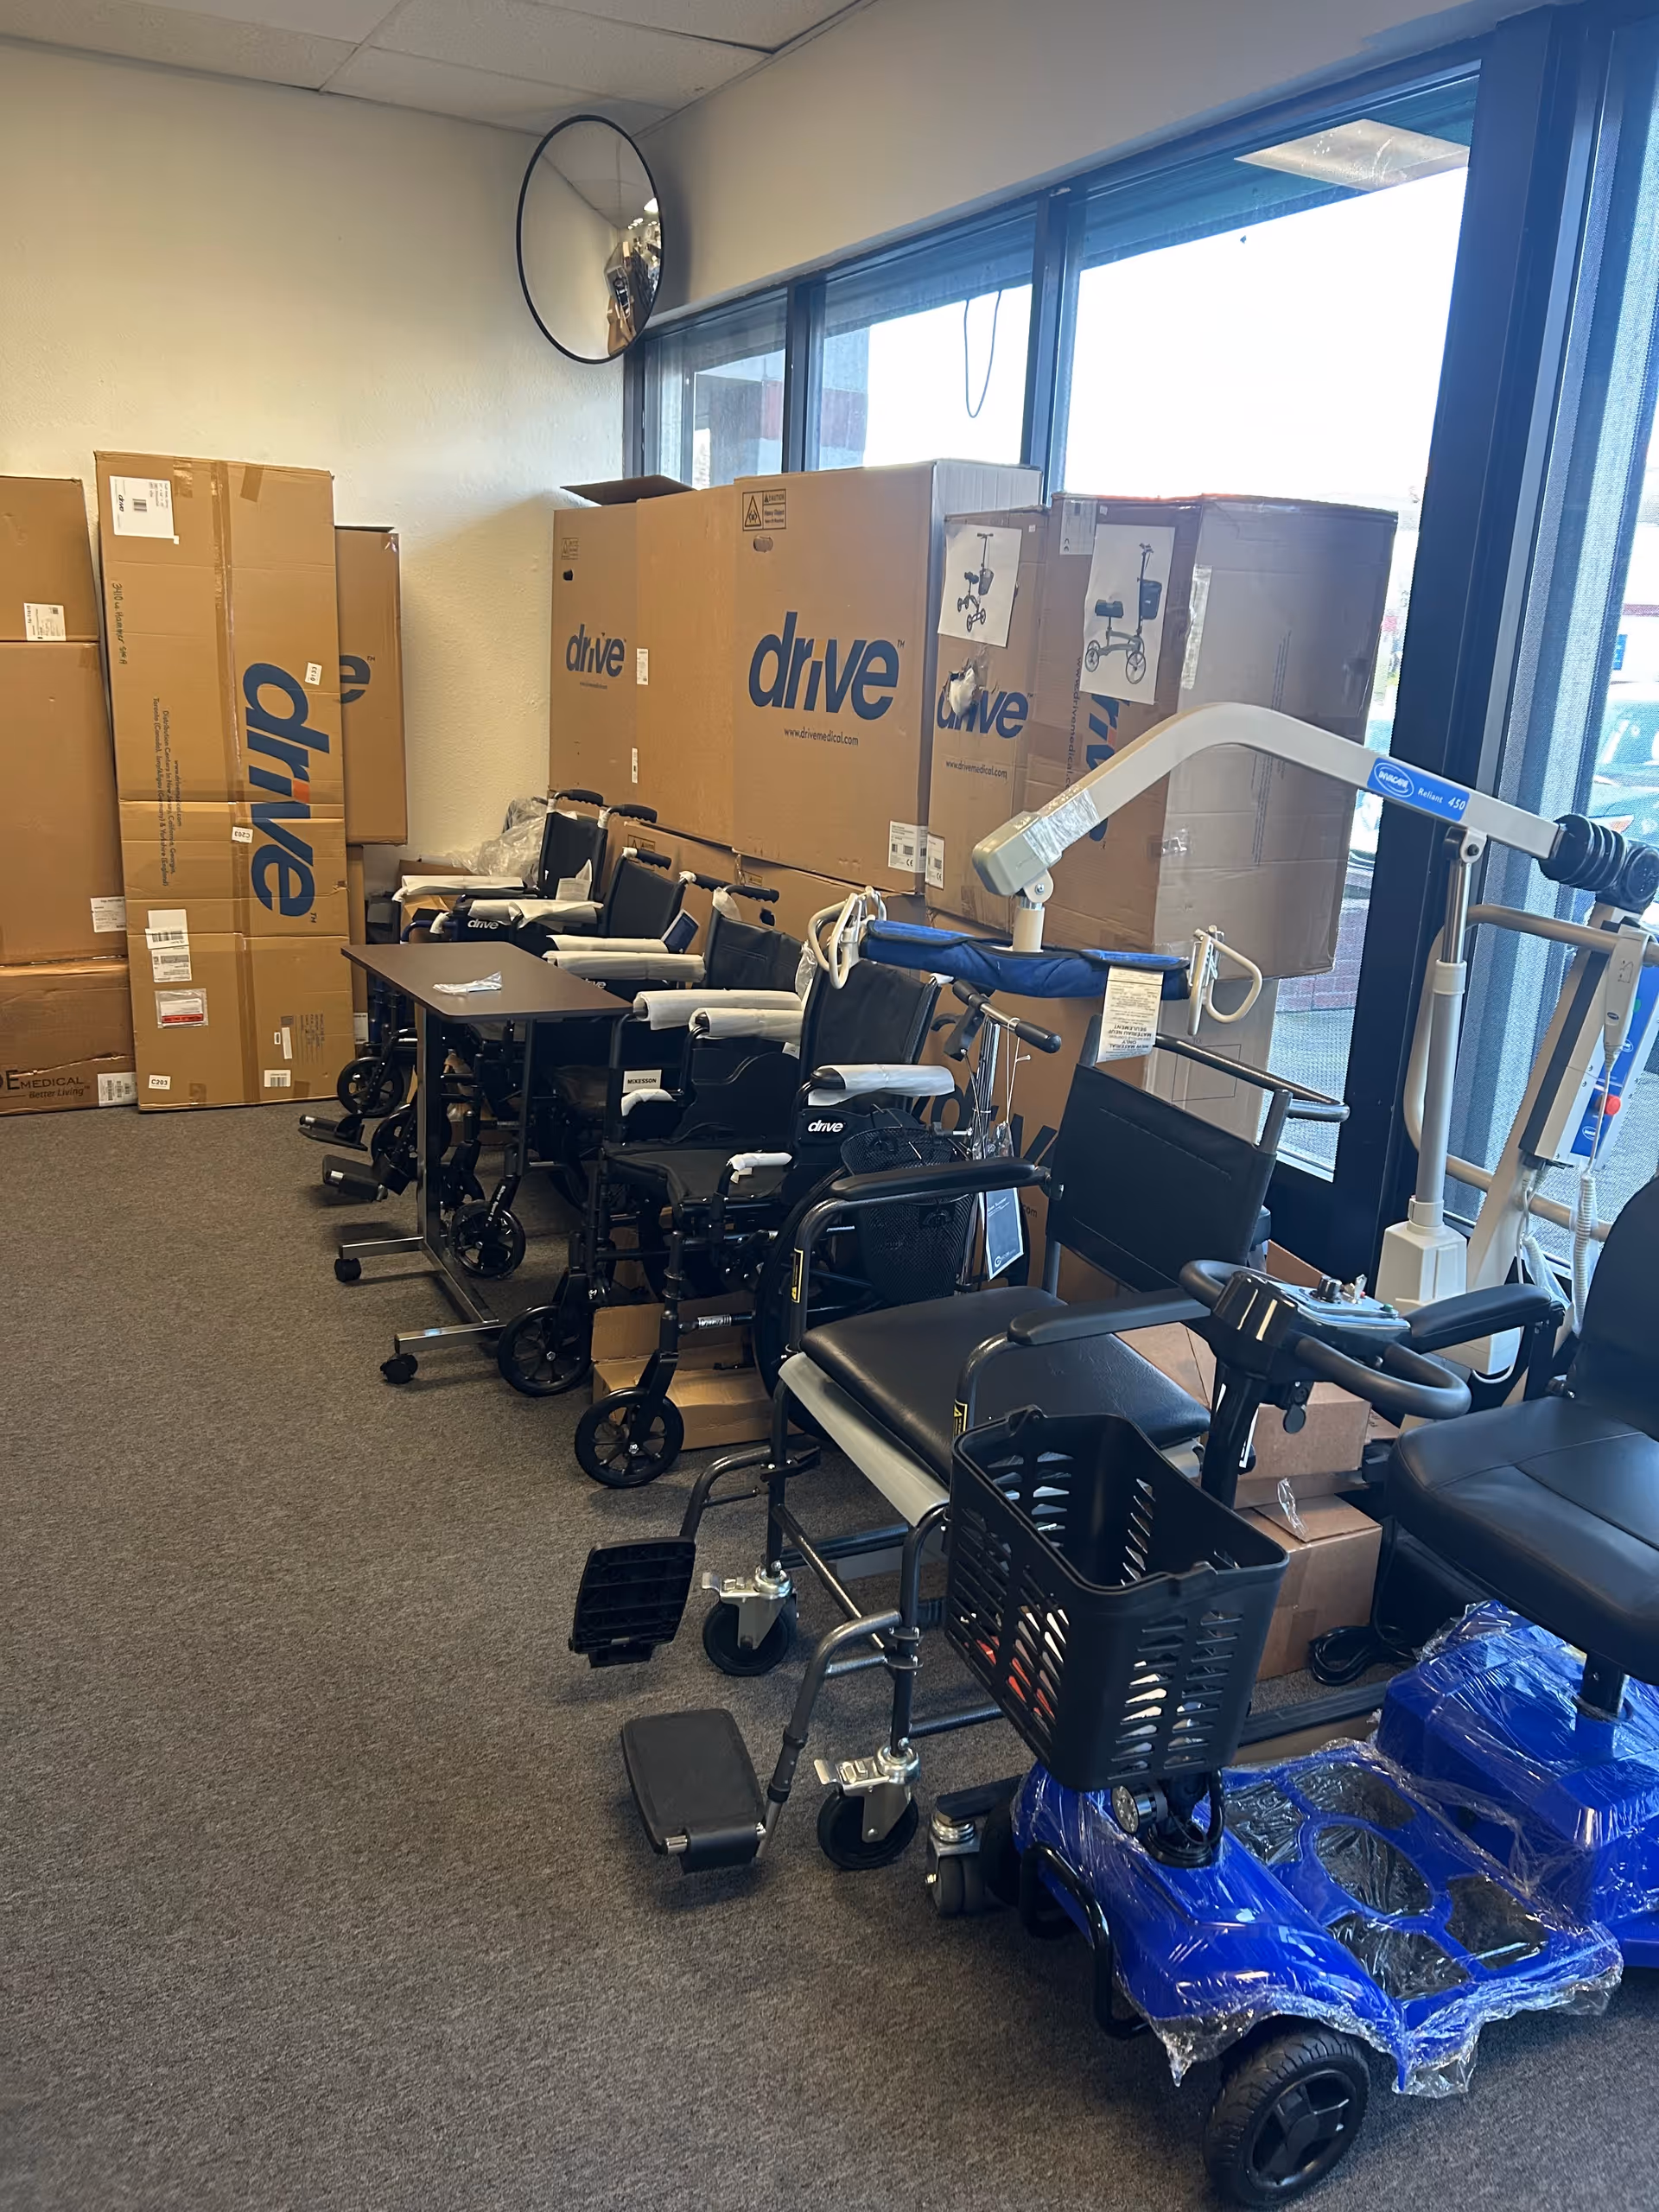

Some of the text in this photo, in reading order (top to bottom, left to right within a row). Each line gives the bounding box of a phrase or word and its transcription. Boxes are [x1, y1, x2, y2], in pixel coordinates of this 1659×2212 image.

[566, 624, 625, 677] drive
[748, 611, 899, 720] drive
[784, 727, 859, 746] www.drivemedical.com
[946, 760, 1007, 779] www.drivemedical.com
[243, 663, 330, 917] drive
[1418, 787, 1466, 810] Reliant 450
[467, 918, 499, 930] drive
[20, 1077, 85, 1090] MEDICAL
[29, 1086, 84, 1098] Better Living
[808, 1120, 843, 1132] drive
